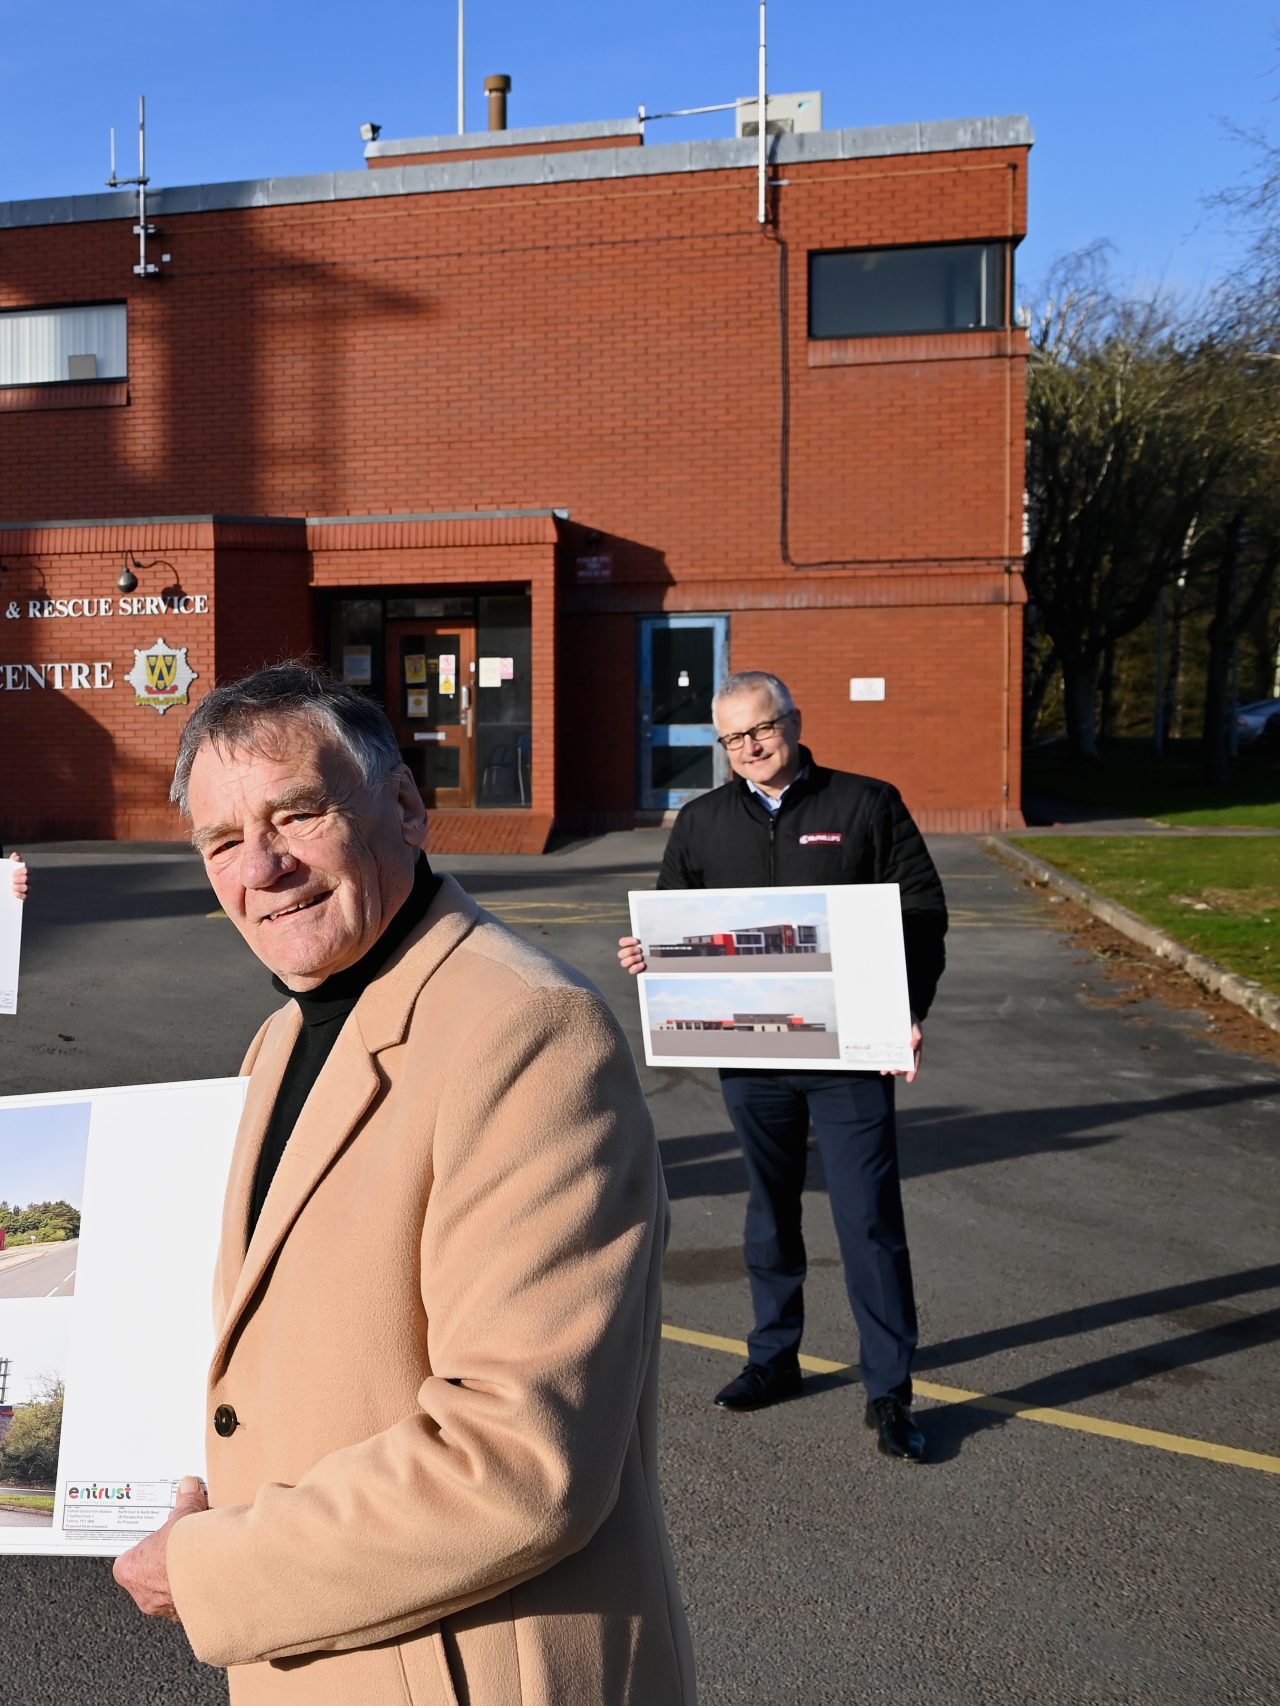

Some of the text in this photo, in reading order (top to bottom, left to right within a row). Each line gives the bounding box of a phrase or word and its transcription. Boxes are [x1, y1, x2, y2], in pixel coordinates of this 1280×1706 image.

[5, 600, 21, 619] &
[28, 597, 114, 618] RESCUE
[119, 594, 209, 616] SERVICE
[68, 1483, 132, 1500] entrust
